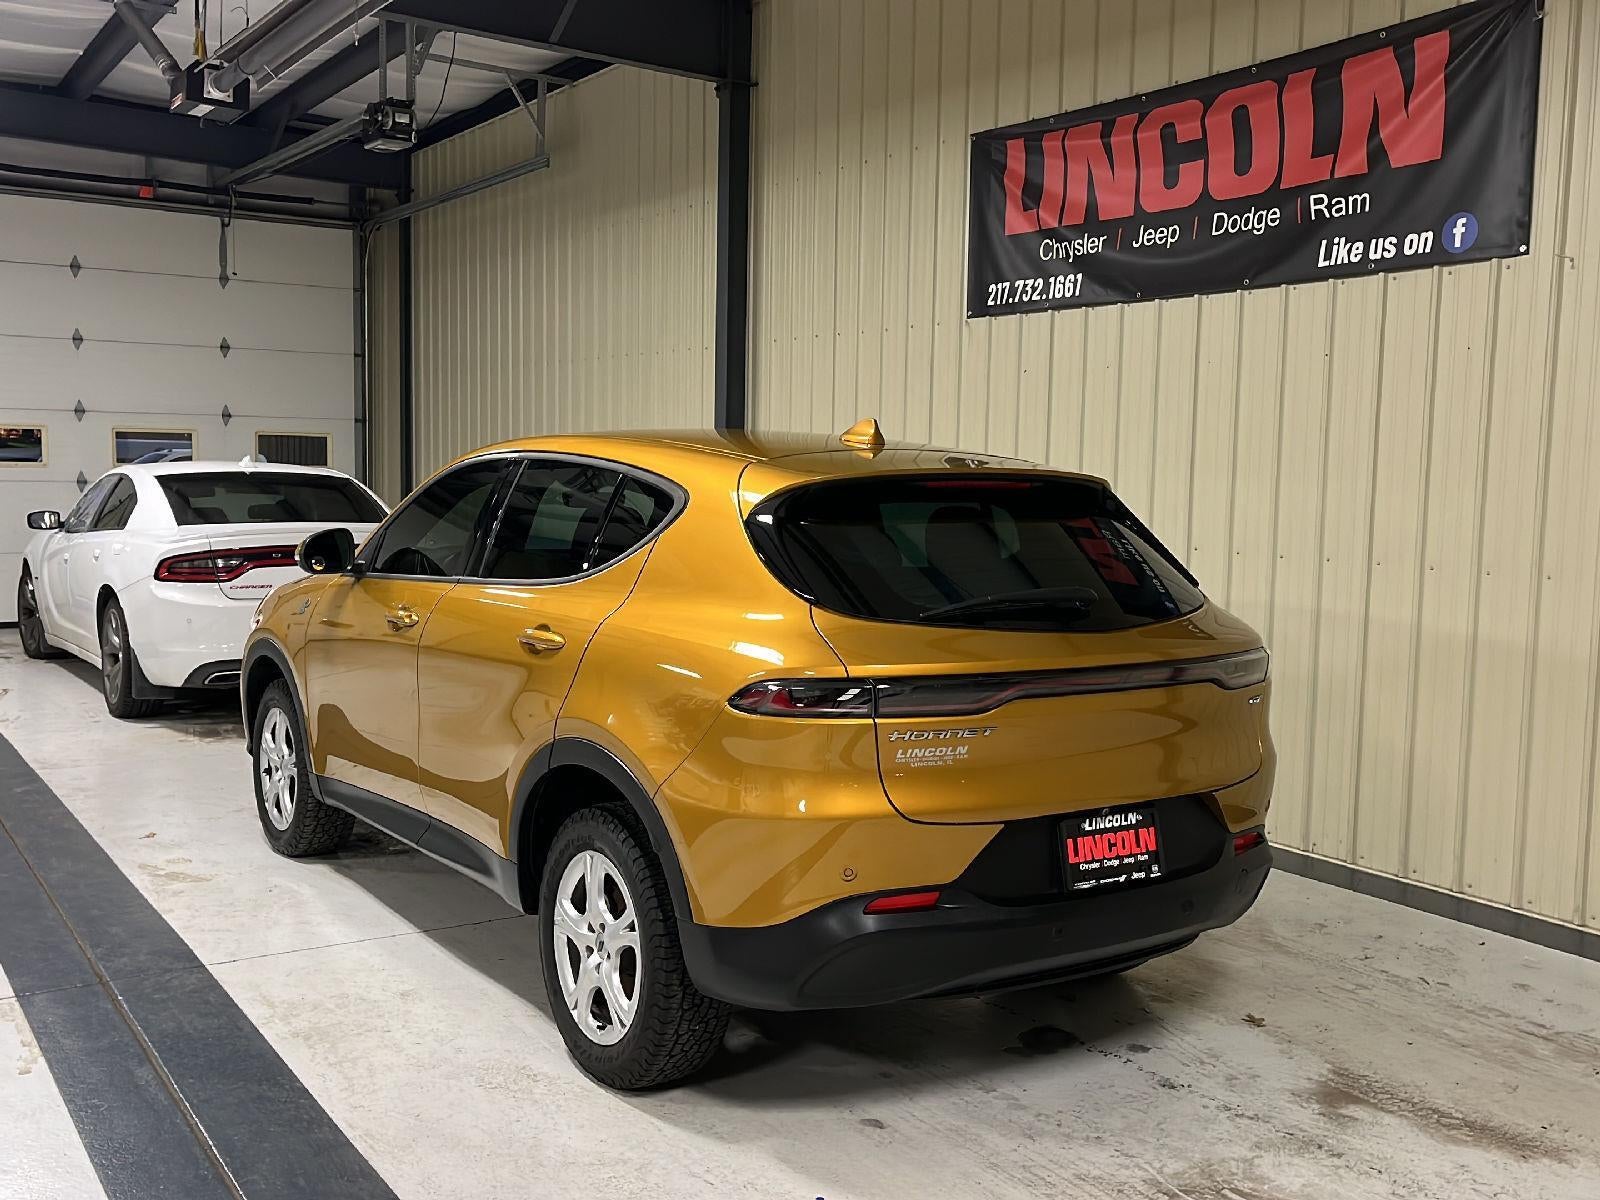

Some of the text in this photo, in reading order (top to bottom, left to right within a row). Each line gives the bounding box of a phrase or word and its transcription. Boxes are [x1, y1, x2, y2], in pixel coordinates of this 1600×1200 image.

[1004, 29, 1449, 236] LINCOLN
[1039, 192, 1370, 262] Chrysler Jeep Dodge Ram
[1317, 236, 1363, 267] Like
[1368, 236, 1397, 260] us
[1403, 230, 1434, 256] on
[987, 273, 1083, 306] 217.732.1661
[888, 727, 999, 743] HORNET
[896, 745, 969, 759] LINCOLN
[1084, 812, 1137, 831] LINCOLN
[1067, 827, 1157, 864] LINCOLN
[1079, 862, 1100, 871] Chrysler
[1104, 859, 1120, 867] Dodge
[1122, 856, 1135, 864] Jeep
